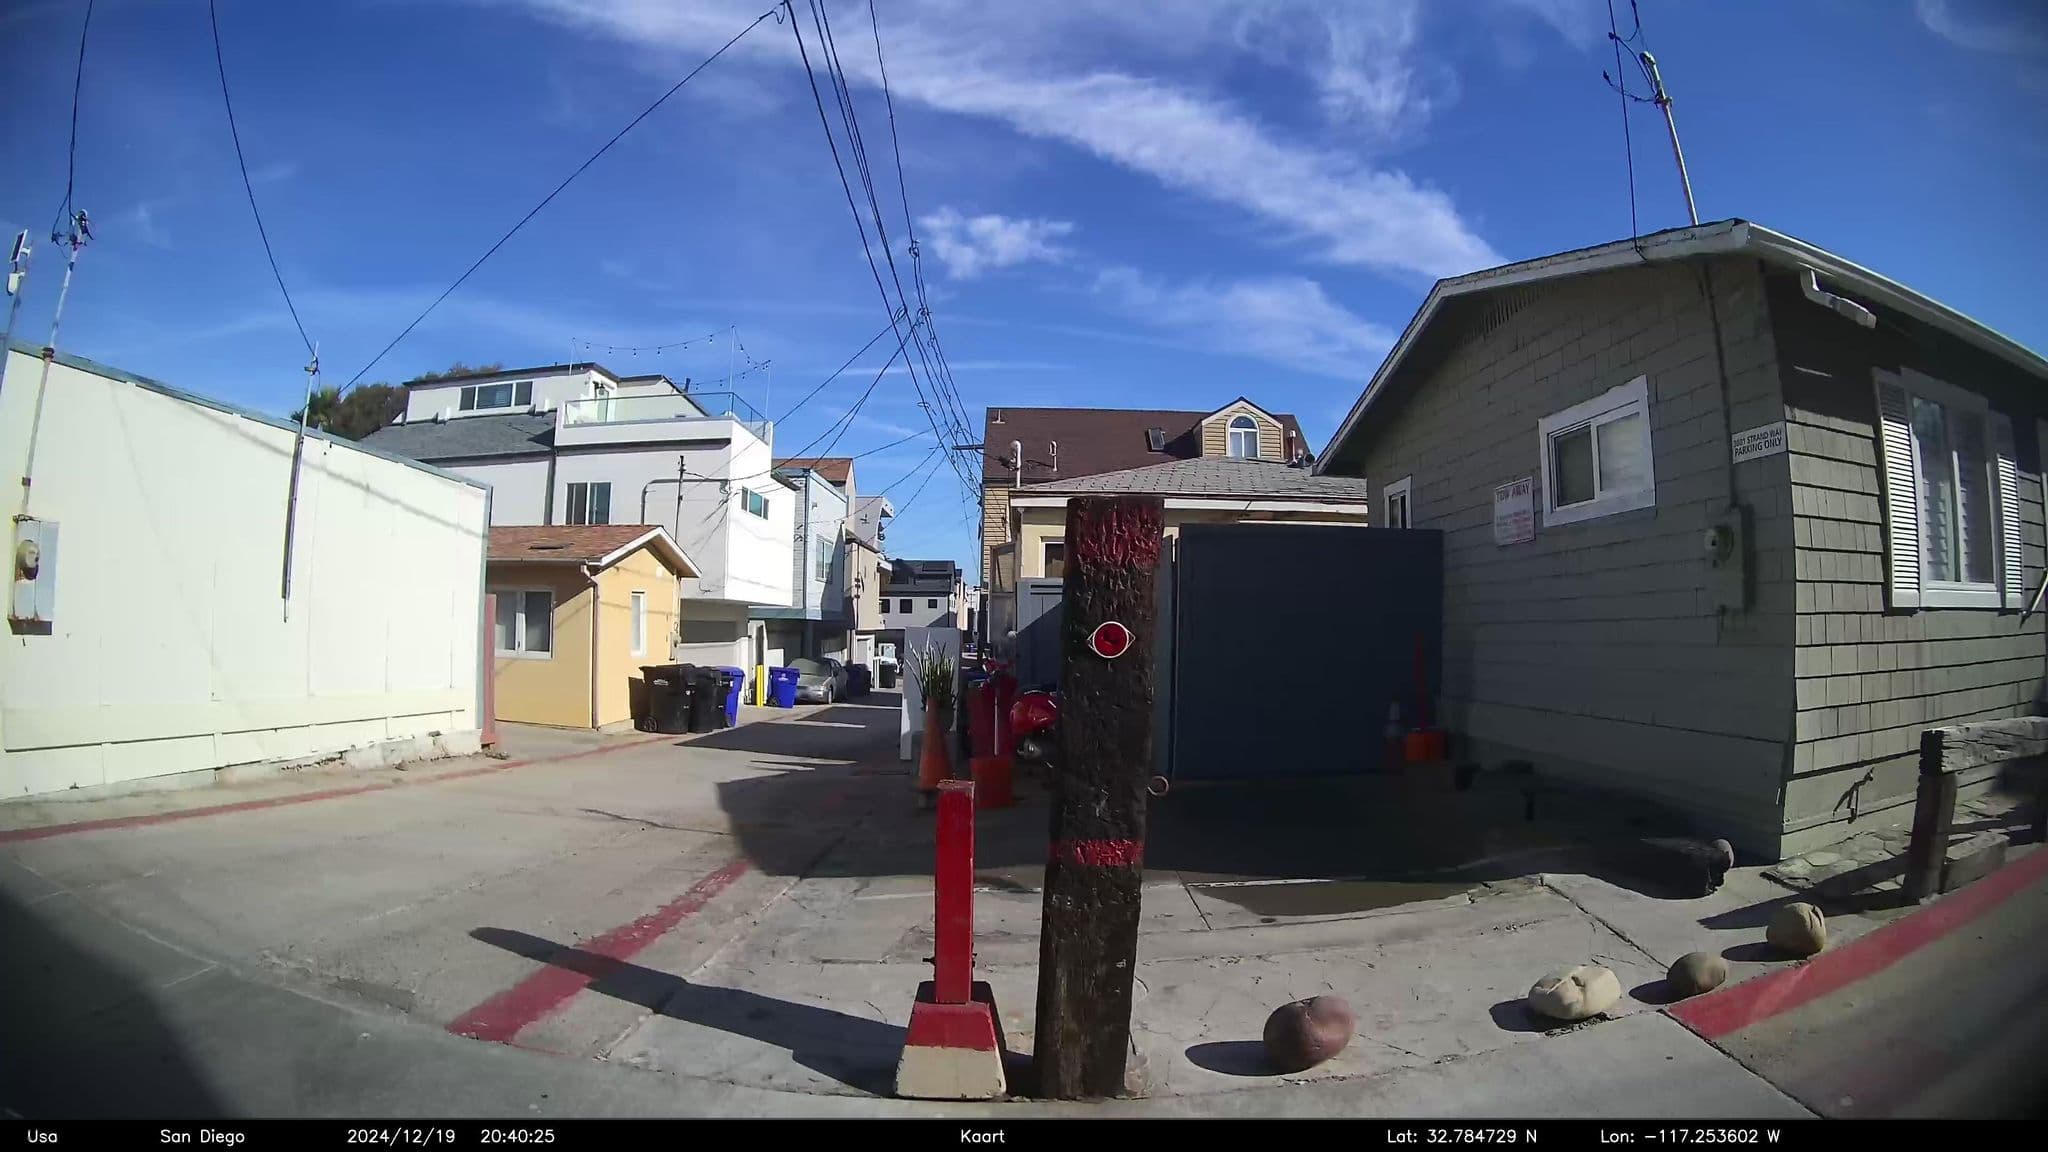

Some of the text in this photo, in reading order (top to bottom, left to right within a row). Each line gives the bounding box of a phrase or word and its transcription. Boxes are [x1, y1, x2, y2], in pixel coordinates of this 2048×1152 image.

[1747, 431, 1769, 444] STRAND
[1735, 436, 1782, 457] PARKING ONLY
[1511, 482, 1529, 499] AWAY
